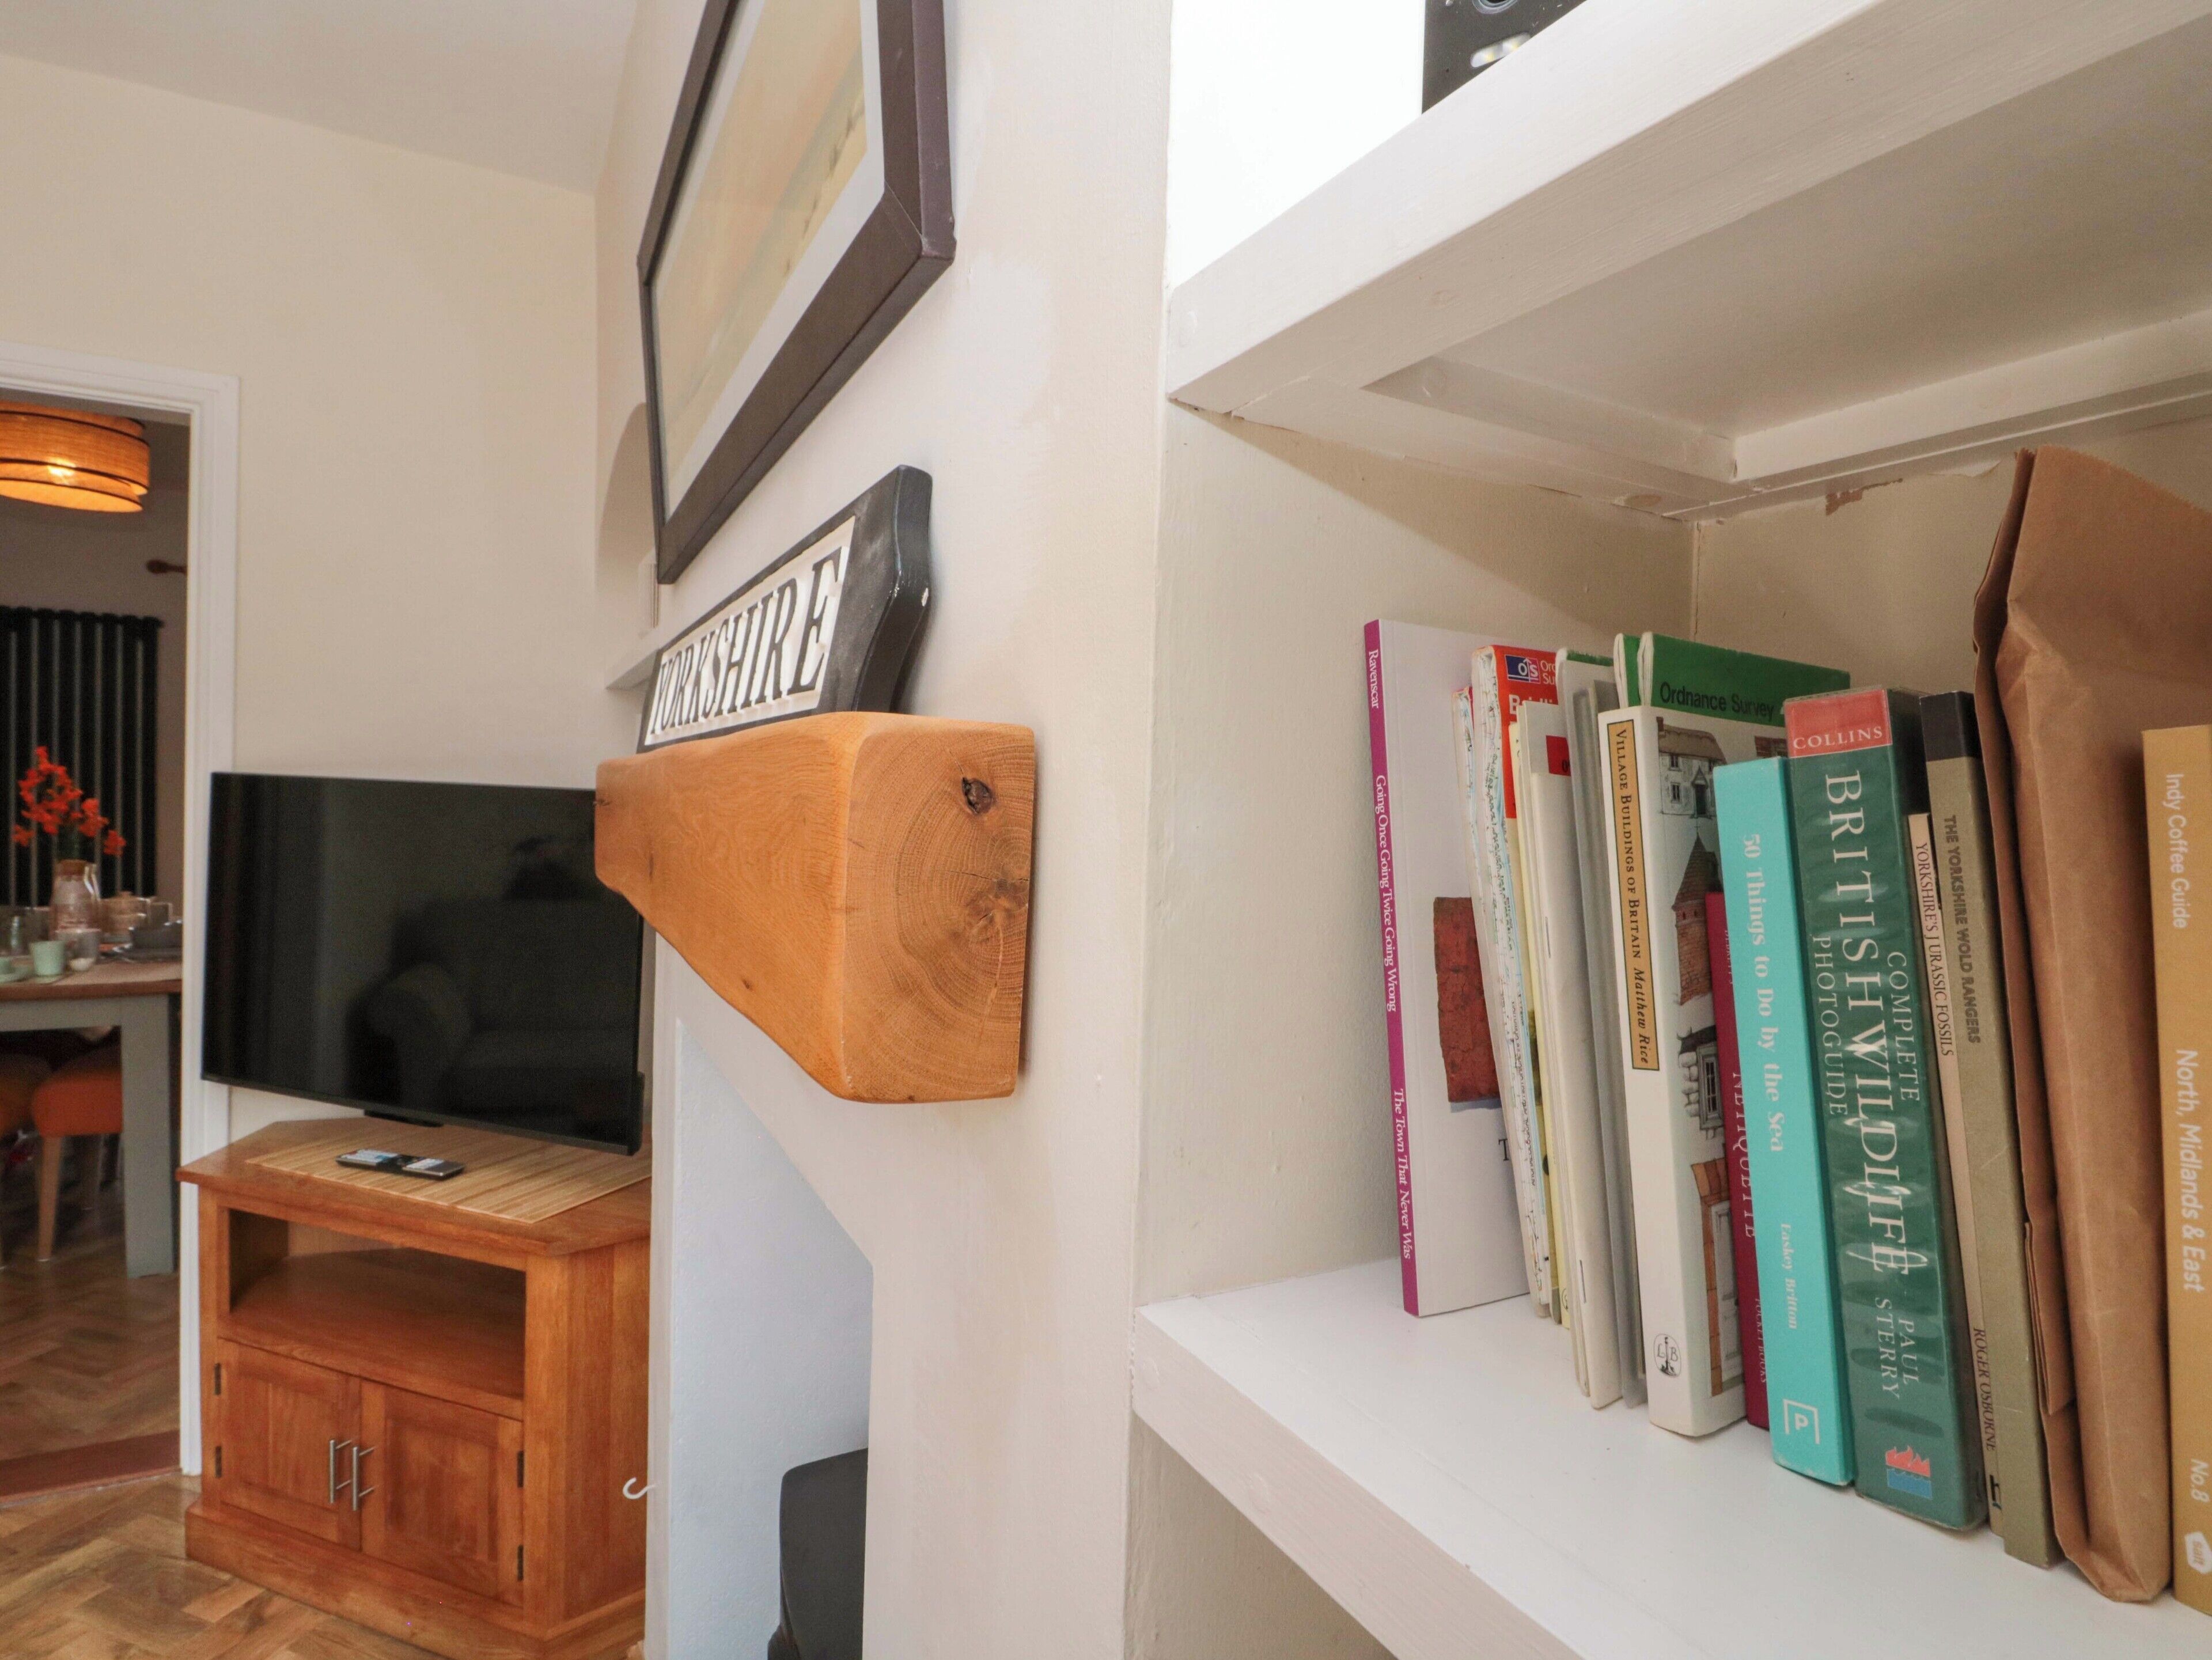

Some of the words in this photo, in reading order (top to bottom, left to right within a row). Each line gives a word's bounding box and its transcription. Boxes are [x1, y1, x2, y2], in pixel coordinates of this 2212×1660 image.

[650, 546, 843, 734] YORKSHIRE
[1369, 649, 1379, 709] Ravenscar
[1660, 681, 1726, 711] Ordnance
[1732, 693, 1775, 721] Survey
[1616, 729, 1628, 790] VILLAGE
[1793, 725, 1883, 750] COLLINS
[1376, 775, 1387, 814] Going
[2162, 774, 2185, 810] Indy
[1378, 814, 1389, 848] Once
[1620, 794, 1635, 872] BUILDINGS
[1743, 833, 1762, 858] 50
[1944, 814, 1959, 844] THE
[2168, 814, 2188, 874] Coffee
[1380, 849, 1391, 889] Going
[1825, 770, 1884, 1011] BRITISH
[1948, 846, 1968, 924] YORKSHIRE
[1382, 889, 1393, 926] Twice
[1746, 867, 1767, 946] Things
[2171, 877, 2191, 928] Guide
[1384, 927, 1395, 967] Going
[1628, 899, 1641, 958] BRITAIN
[1957, 928, 1973, 973] WOLD
[1754, 955, 1771, 978] to
[1387, 968, 1398, 1012] Wrong
[1634, 968, 1646, 1028] Matthew
[1757, 988, 1774, 1017] Do
[1962, 976, 1981, 1044] RANGERS
[1758, 1026, 1779, 1052] by
[1813, 935, 1848, 1116] PHOTOGUIDE
[1887, 952, 1921, 1101] COMPLETE
[1936, 1005, 1954, 1057] FOSSILS
[1639, 1034, 1650, 1064] Rice
[1394, 1089, 1404, 1114] The
[1764, 1063, 1783, 1102] the
[2175, 1049, 2200, 1116] North,
[1396, 1116, 1406, 1153] Town
[1768, 1111, 1785, 1152] Sea
[1850, 1020, 1909, 1275] WILDLIFE
[1398, 1155, 1407, 1185] That
[2179, 1123, 2203, 1219] Midlands
[1400, 1189, 1411, 1229] Never
[1402, 1233, 1413, 1260] Was
[2182, 1224, 2206, 1240] &
[2182, 1245, 2206, 1293] East
[1785, 1278, 1797, 1329] Britton
[1875, 1297, 1900, 1400] STERRY
[1898, 1317, 1919, 1385] PAUL
[1974, 1326, 1990, 1378] ROGER
[1979, 1382, 1996, 1451] OSBORNE
[2191, 1458, 2210, 1503] No.8
